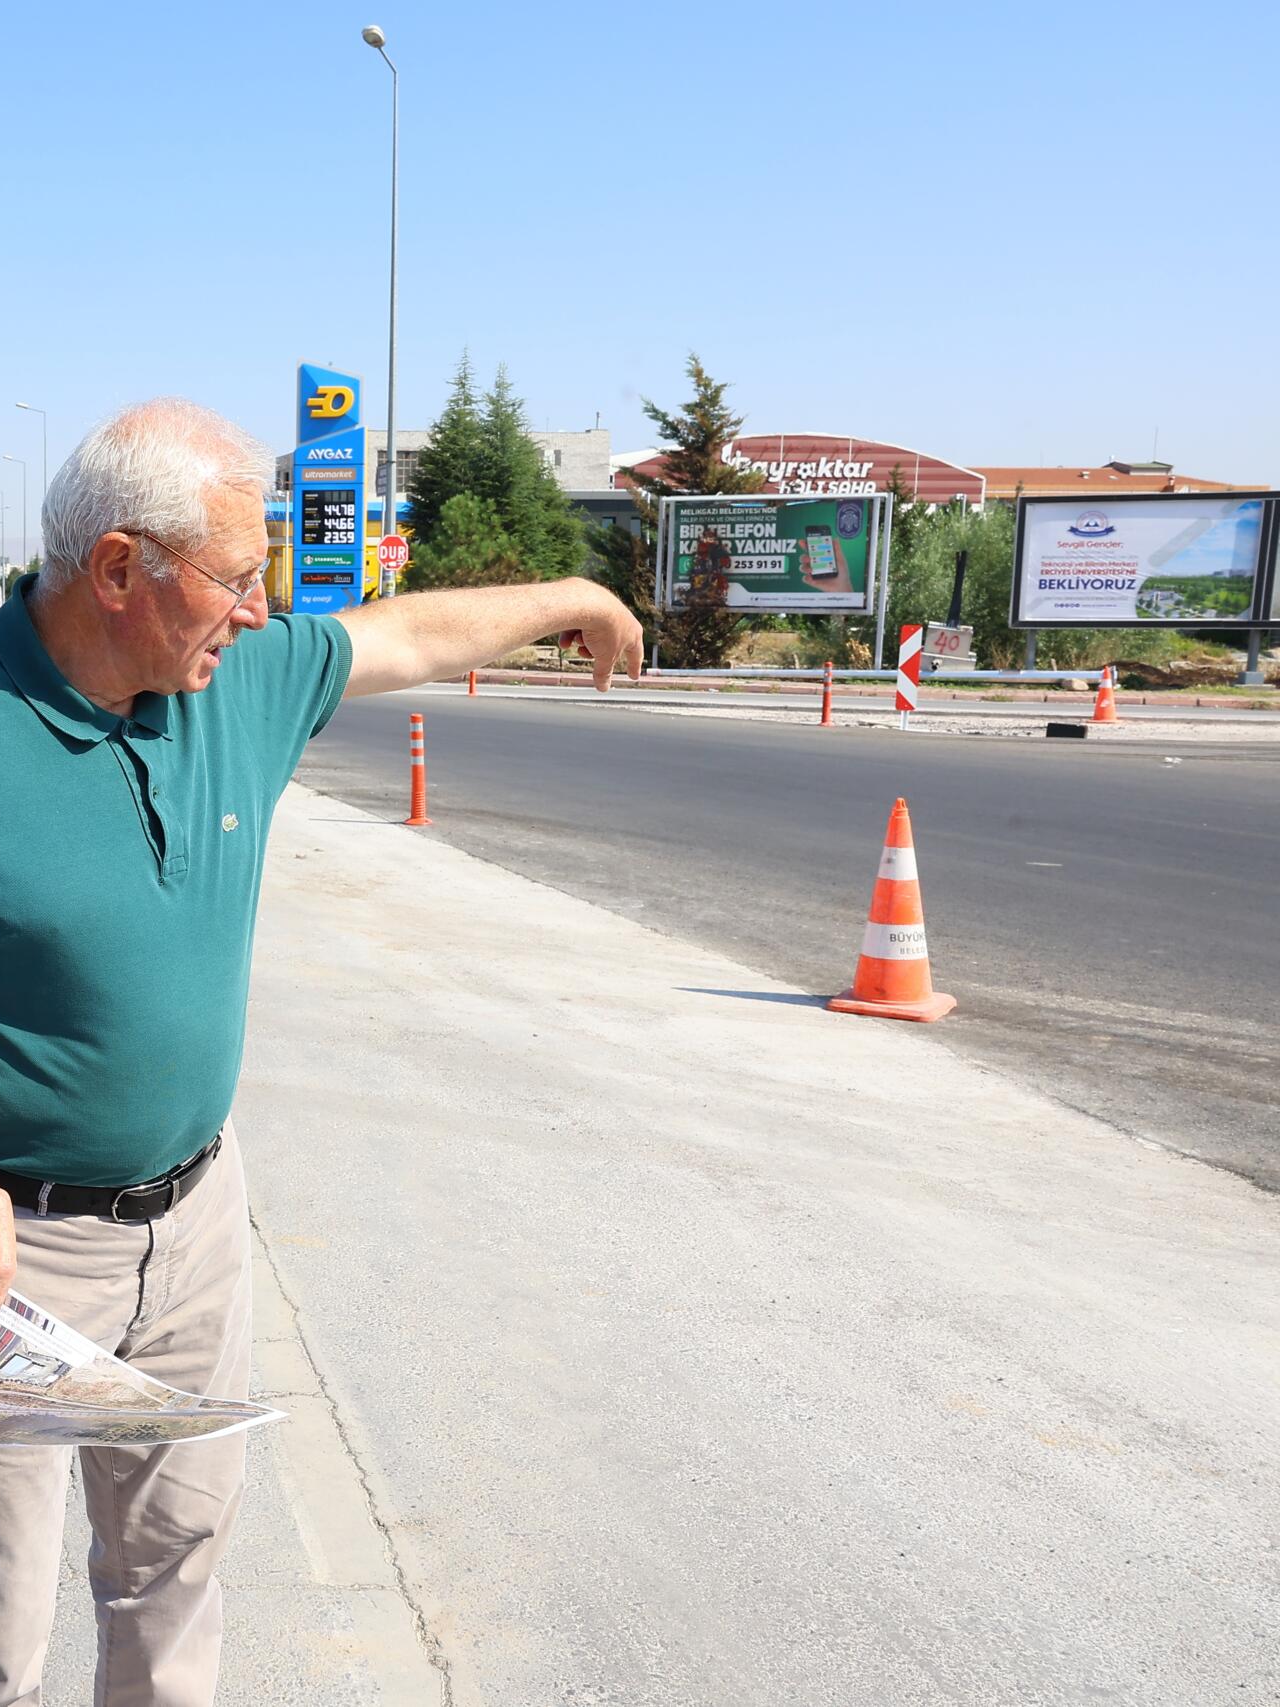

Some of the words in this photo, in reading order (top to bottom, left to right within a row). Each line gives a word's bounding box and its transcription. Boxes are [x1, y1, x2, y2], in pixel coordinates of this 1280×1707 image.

[307, 448, 353, 460] AYGAZ
[305, 470, 353, 479] ultramarket
[707, 523, 777, 538] TELEFON
[735, 539, 797, 554] YAKINIZ
[1056, 541, 1085, 549] Sevgili
[379, 545, 406, 560] DUR
[734, 560, 753, 569] 253
[756, 560, 768, 568] 91
[770, 560, 782, 568] 91
[1038, 576, 1137, 590] BEKLİYORUZ
[934, 631, 960, 655] 40
